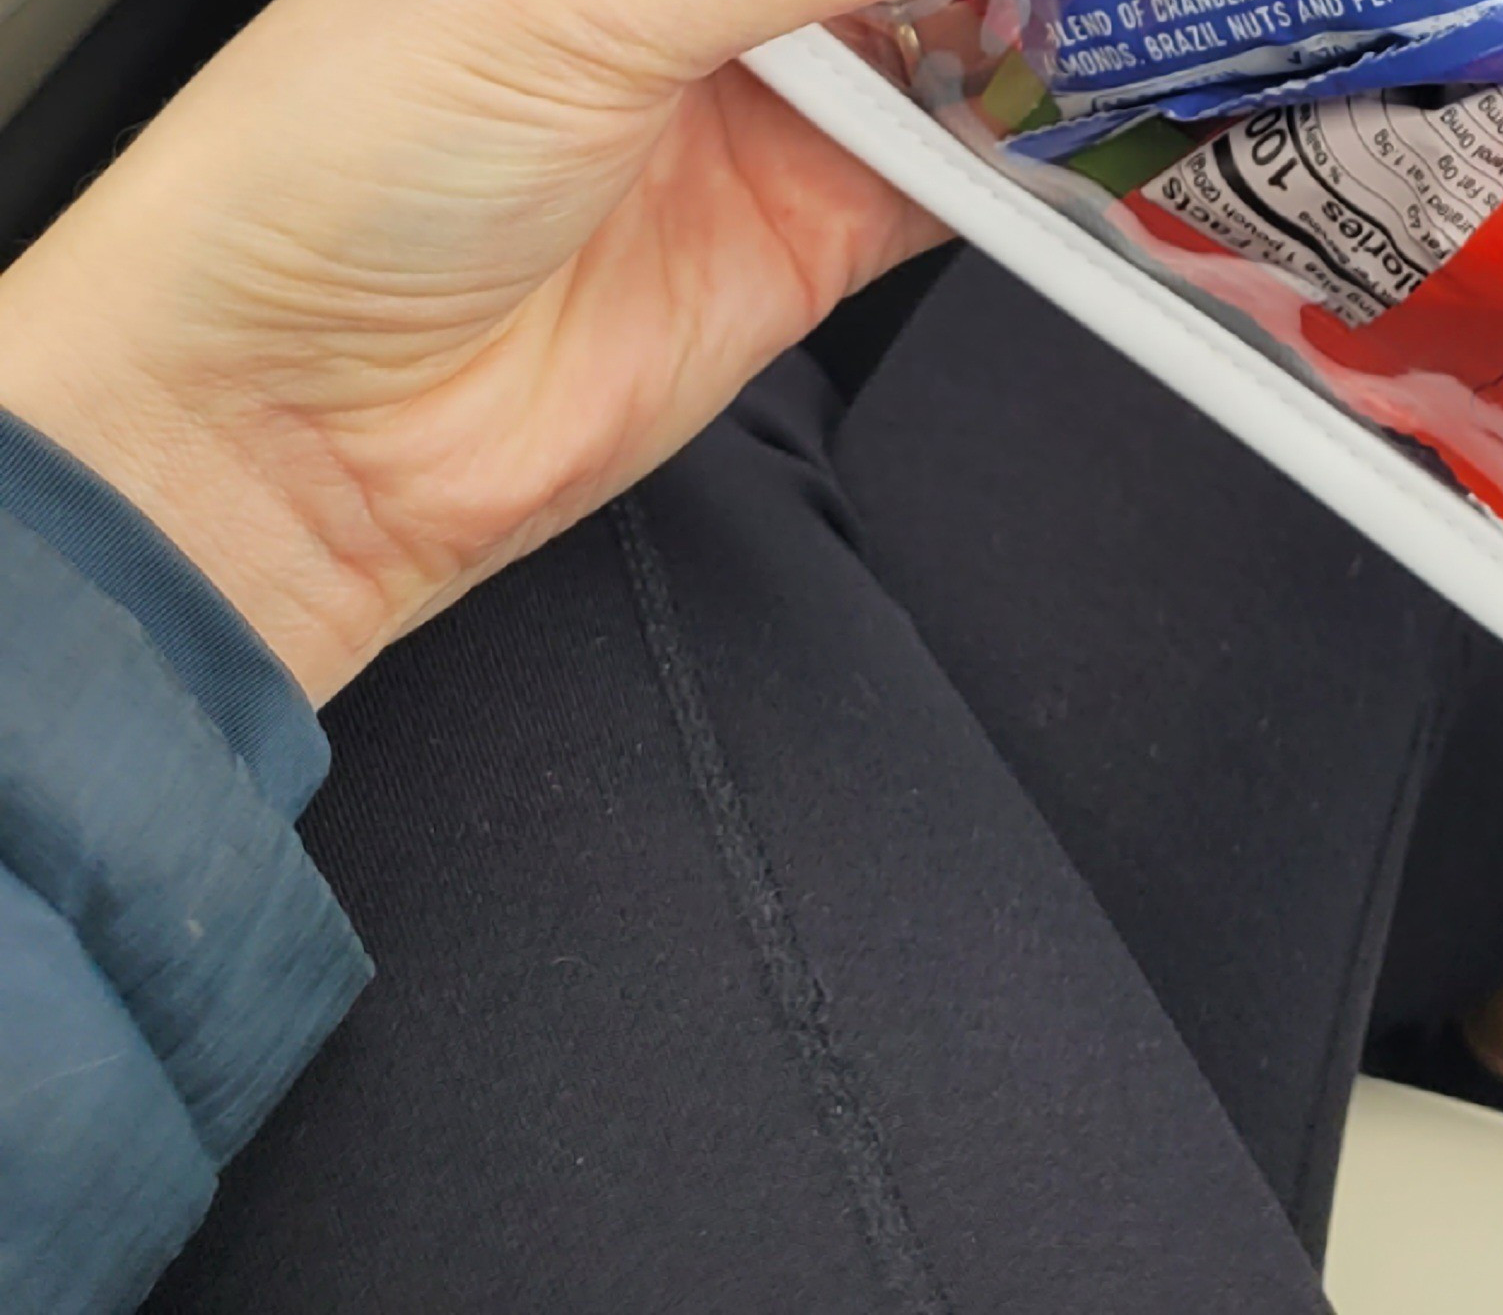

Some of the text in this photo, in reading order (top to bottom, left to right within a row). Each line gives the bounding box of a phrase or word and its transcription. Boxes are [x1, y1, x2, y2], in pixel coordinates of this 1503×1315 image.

[1117, 0, 1147, 31] OF
[1145, 20, 1227, 65] BRAZIL
[1226, 0, 1293, 43] NUTS
[1243, 108, 1296, 193] 100
[1454, 170, 1483, 199] Fat
[1420, 230, 1449, 262] Fat
